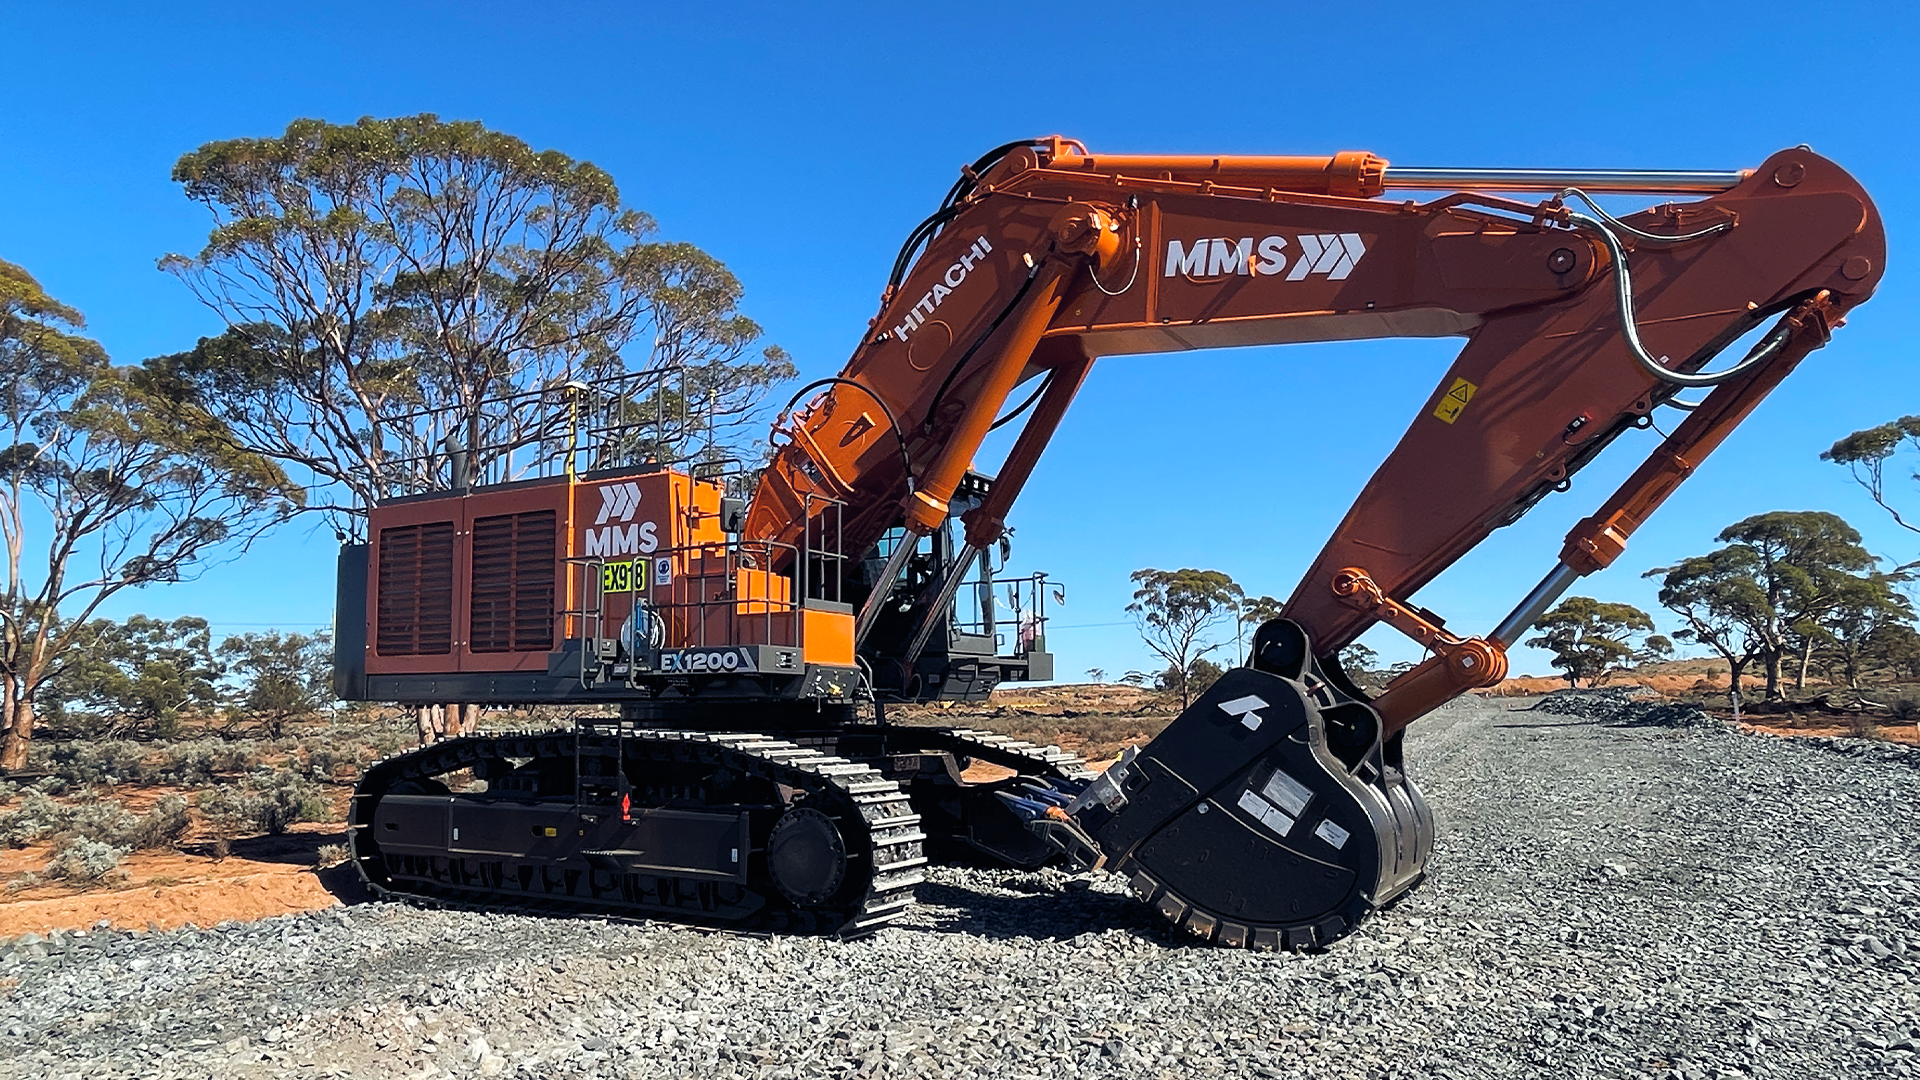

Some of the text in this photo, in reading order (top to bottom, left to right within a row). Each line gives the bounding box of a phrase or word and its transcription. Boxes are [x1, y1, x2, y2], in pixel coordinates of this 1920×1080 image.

[1164, 235, 1287, 278] MMS
[894, 235, 993, 342] HITACHI
[585, 521, 659, 557] MMS
[661, 650, 738, 672] EX1200
